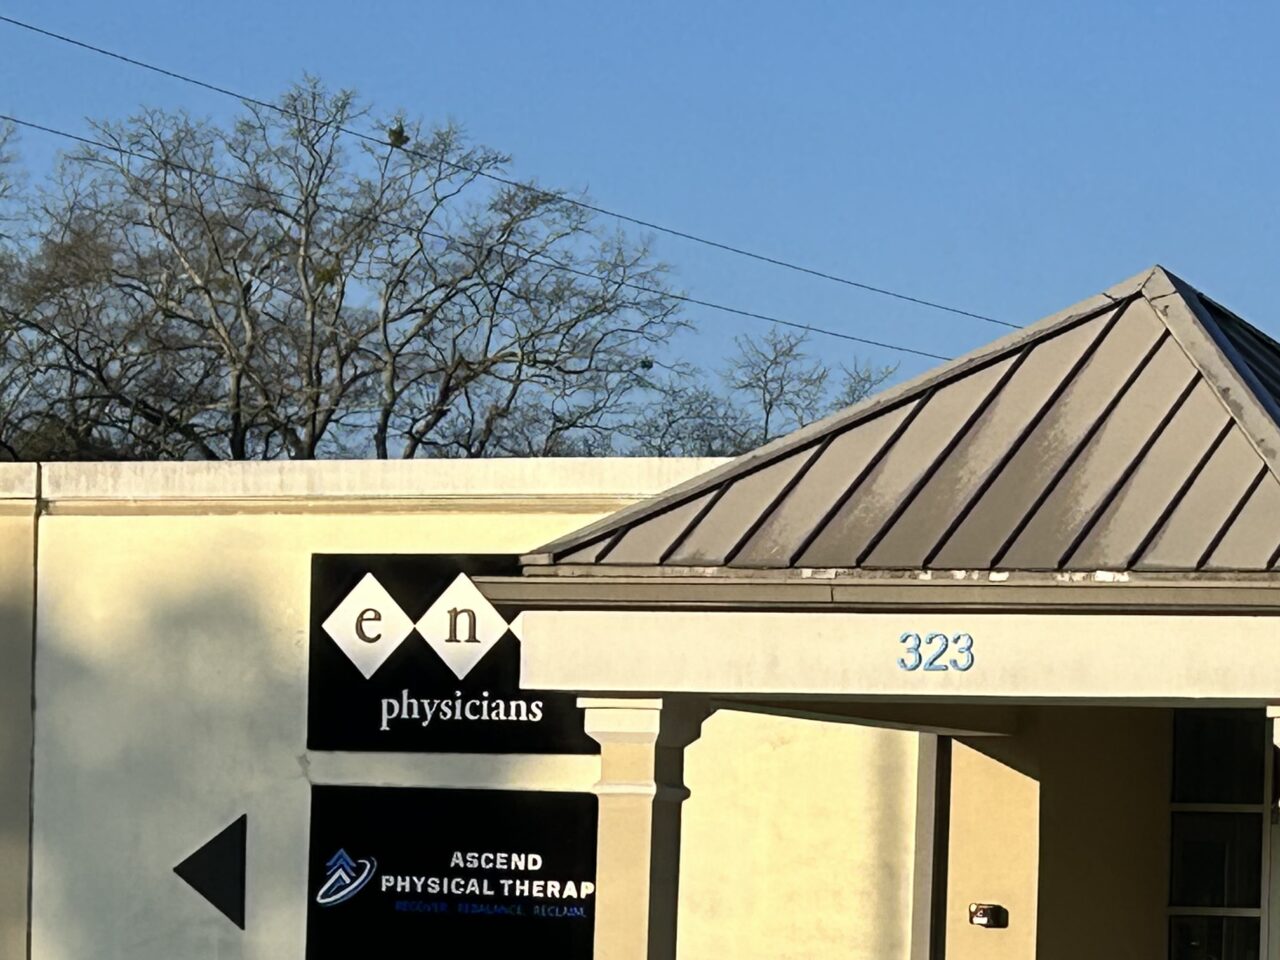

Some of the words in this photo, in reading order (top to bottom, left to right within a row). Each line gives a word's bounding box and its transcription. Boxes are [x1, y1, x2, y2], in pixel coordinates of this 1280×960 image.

[897, 632, 975, 672] 323
[379, 688, 544, 731] physicians
[450, 851, 543, 871] ASCEND
[380, 875, 496, 896] PHYSICAL
[499, 878, 595, 899] THERAP
